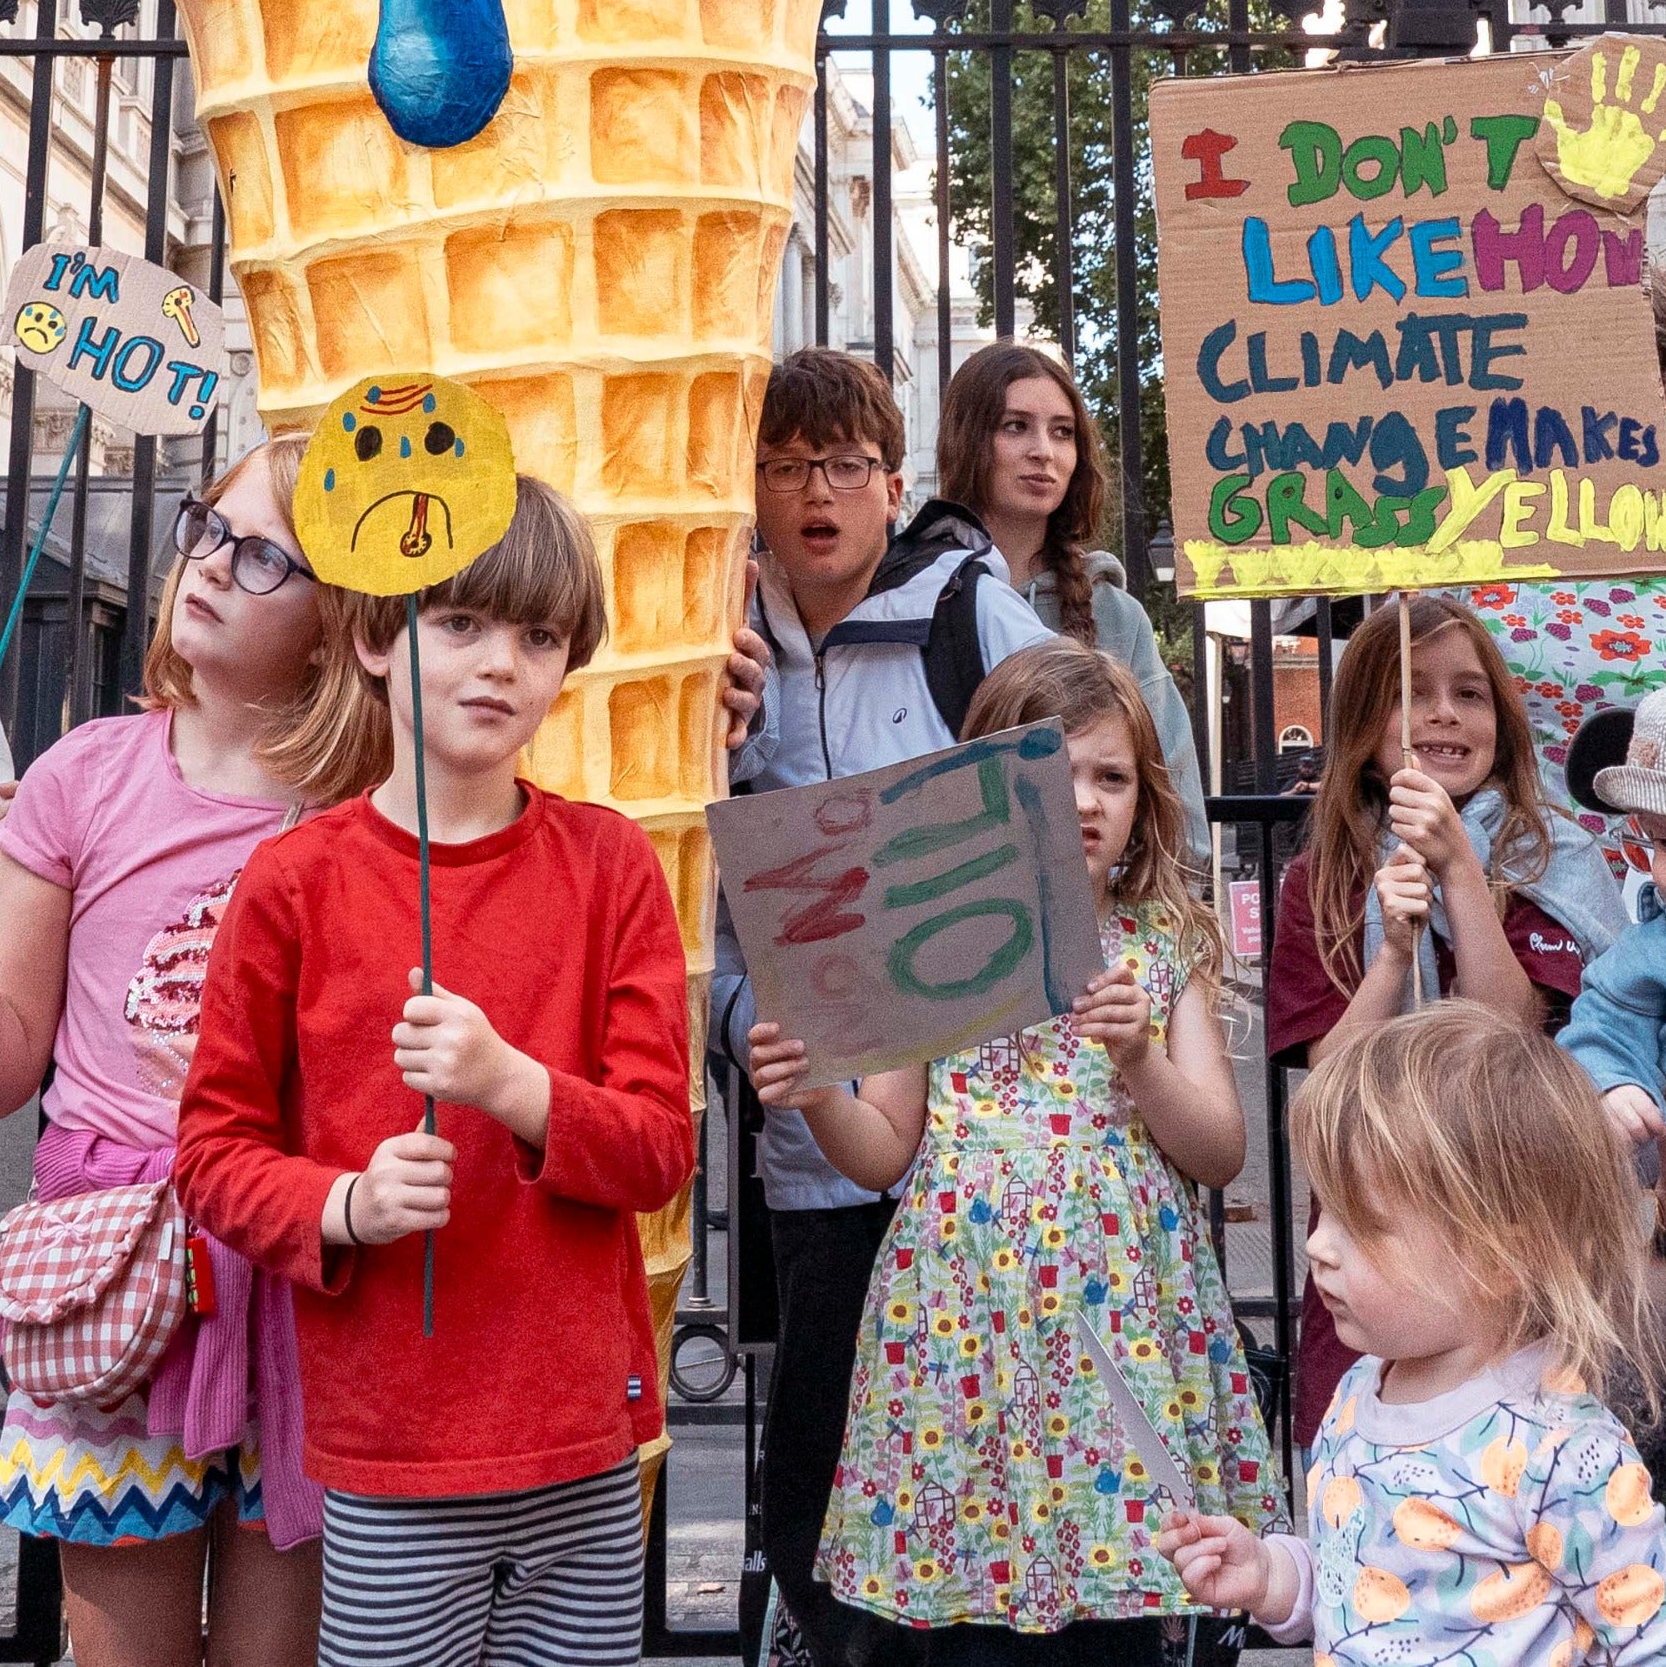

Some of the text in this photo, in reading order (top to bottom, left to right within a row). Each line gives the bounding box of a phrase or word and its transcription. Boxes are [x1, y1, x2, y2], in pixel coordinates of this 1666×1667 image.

[1181, 114, 1541, 208] I DON'T
[43, 251, 121, 305] I'M
[1241, 214, 1471, 306] LIKE
[69, 316, 219, 421] HOT!
[1196, 311, 1529, 405] CLIMATE
[1485, 396, 1661, 473] MAKES
[1208, 466, 1449, 549] GRASS
[870, 756, 1034, 1001] OIL
